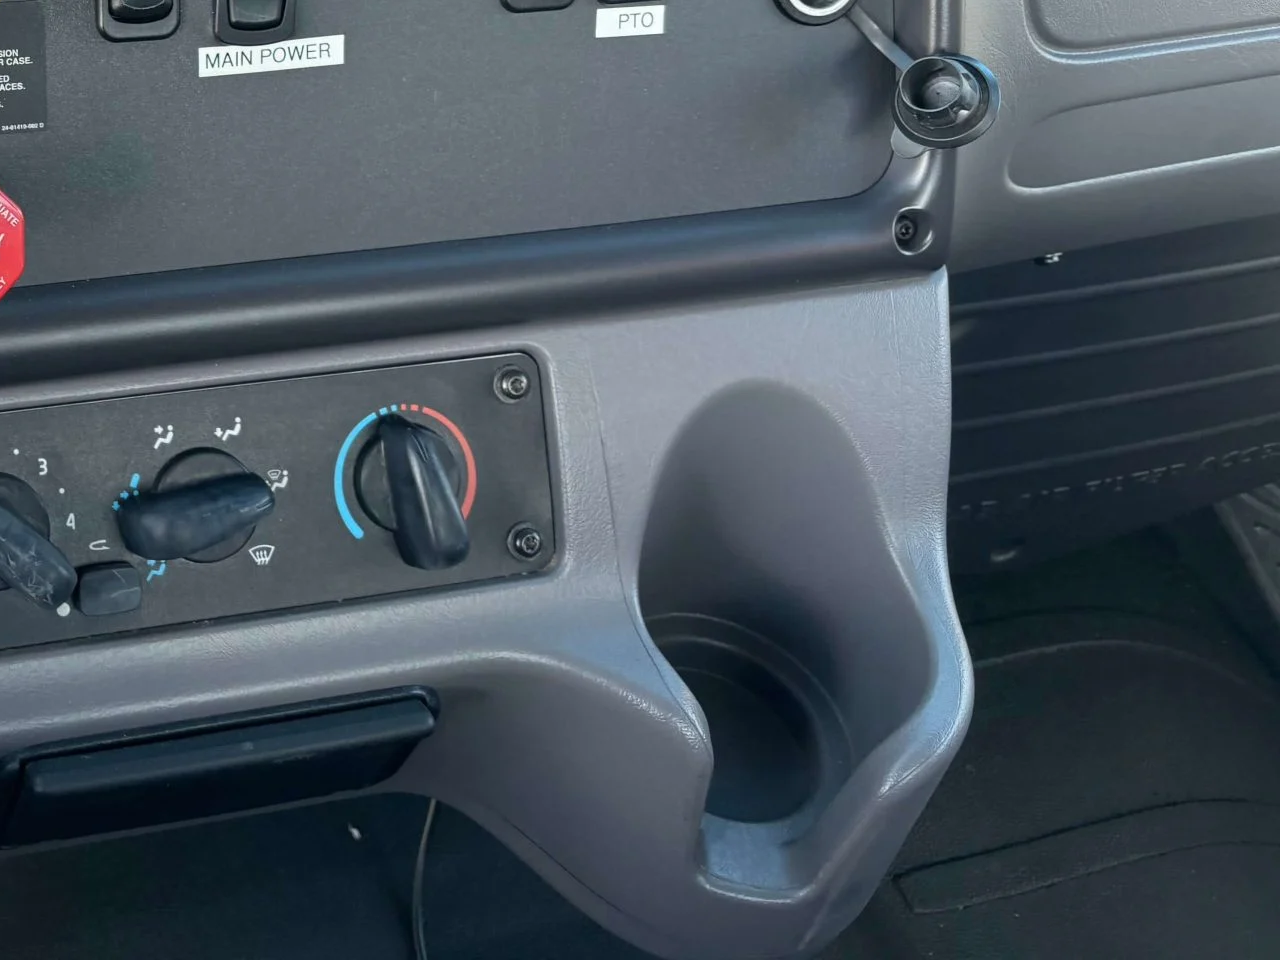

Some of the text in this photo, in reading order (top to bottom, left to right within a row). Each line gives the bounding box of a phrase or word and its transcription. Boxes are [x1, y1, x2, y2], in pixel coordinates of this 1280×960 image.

[619, 11, 654, 29] PTO
[6, 56, 34, 66] CASE.
[205, 43, 331, 69] MAIN POWER
[38, 458, 48, 475] 3
[66, 513, 76, 530] 4
